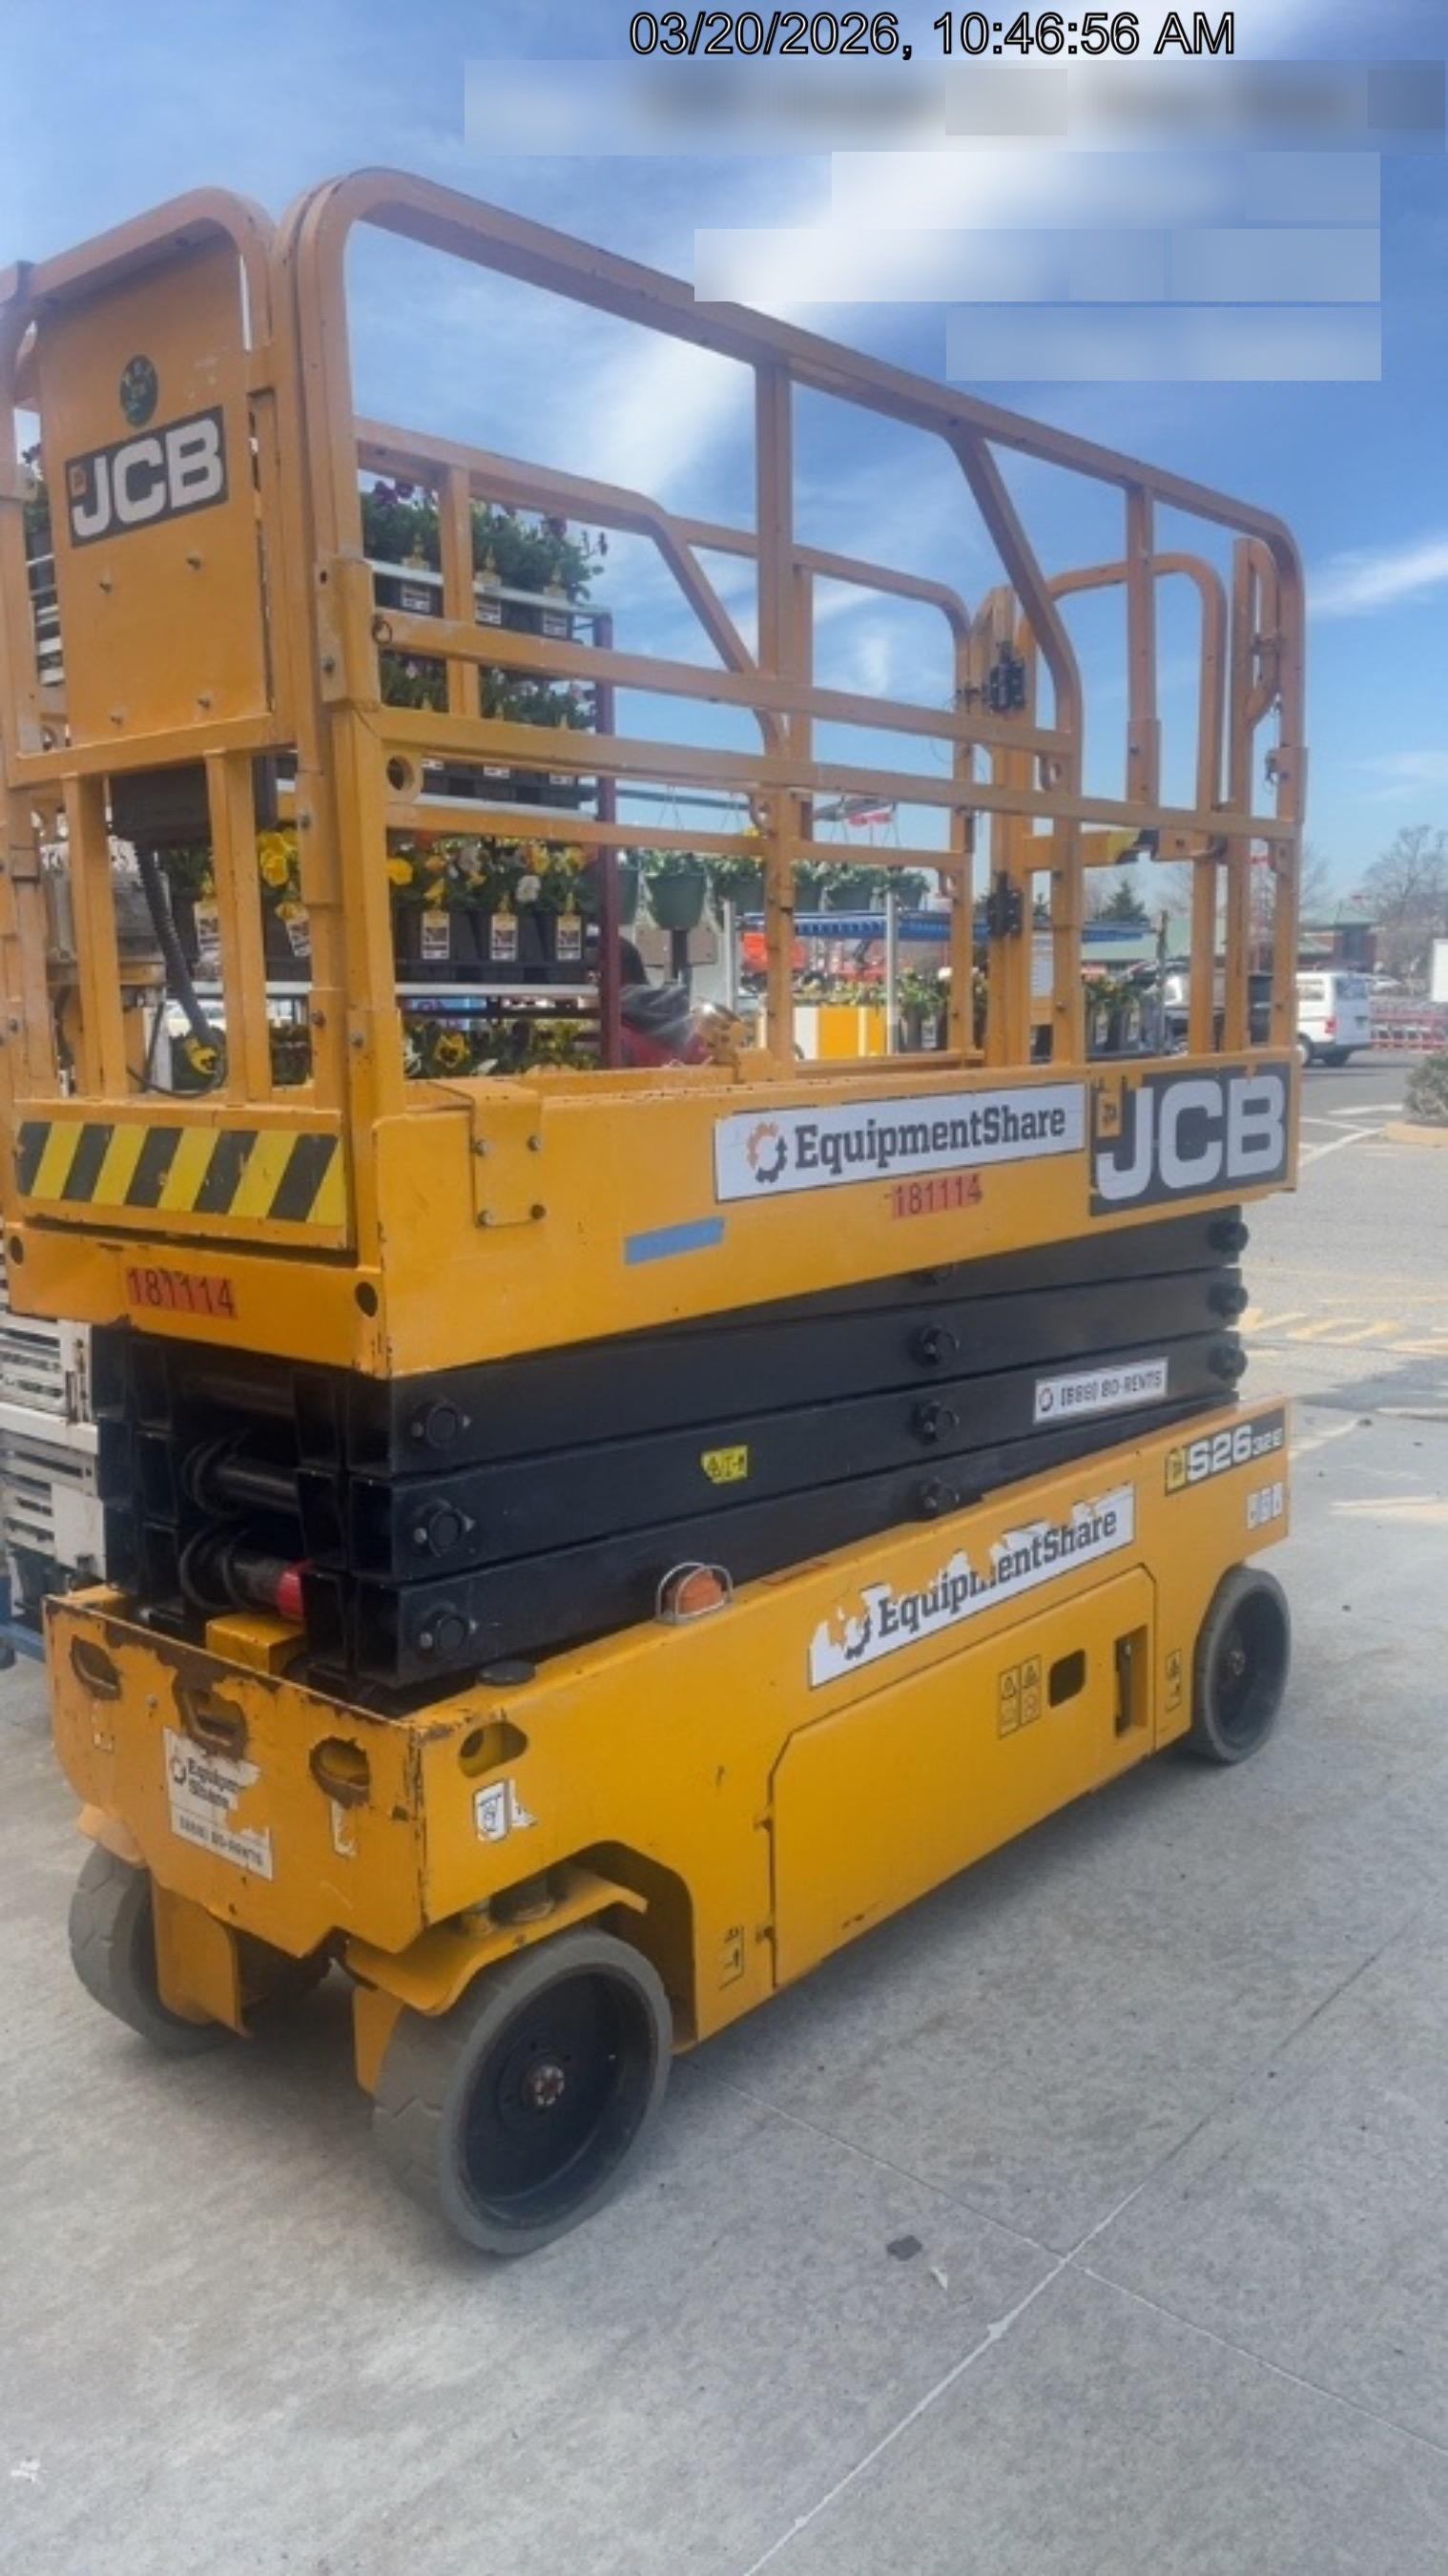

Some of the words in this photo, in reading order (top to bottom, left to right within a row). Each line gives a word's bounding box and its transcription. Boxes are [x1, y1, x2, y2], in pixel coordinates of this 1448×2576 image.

[72, 417, 224, 537] JCB
[795, 1104, 1066, 1175] EquipmentShare
[1097, 1075, 1286, 1200] JCB
[893, 1173, 983, 1218] 181114
[127, 1267, 237, 1317] 181114
[878, 1509, 1117, 1638] EquipentShare
